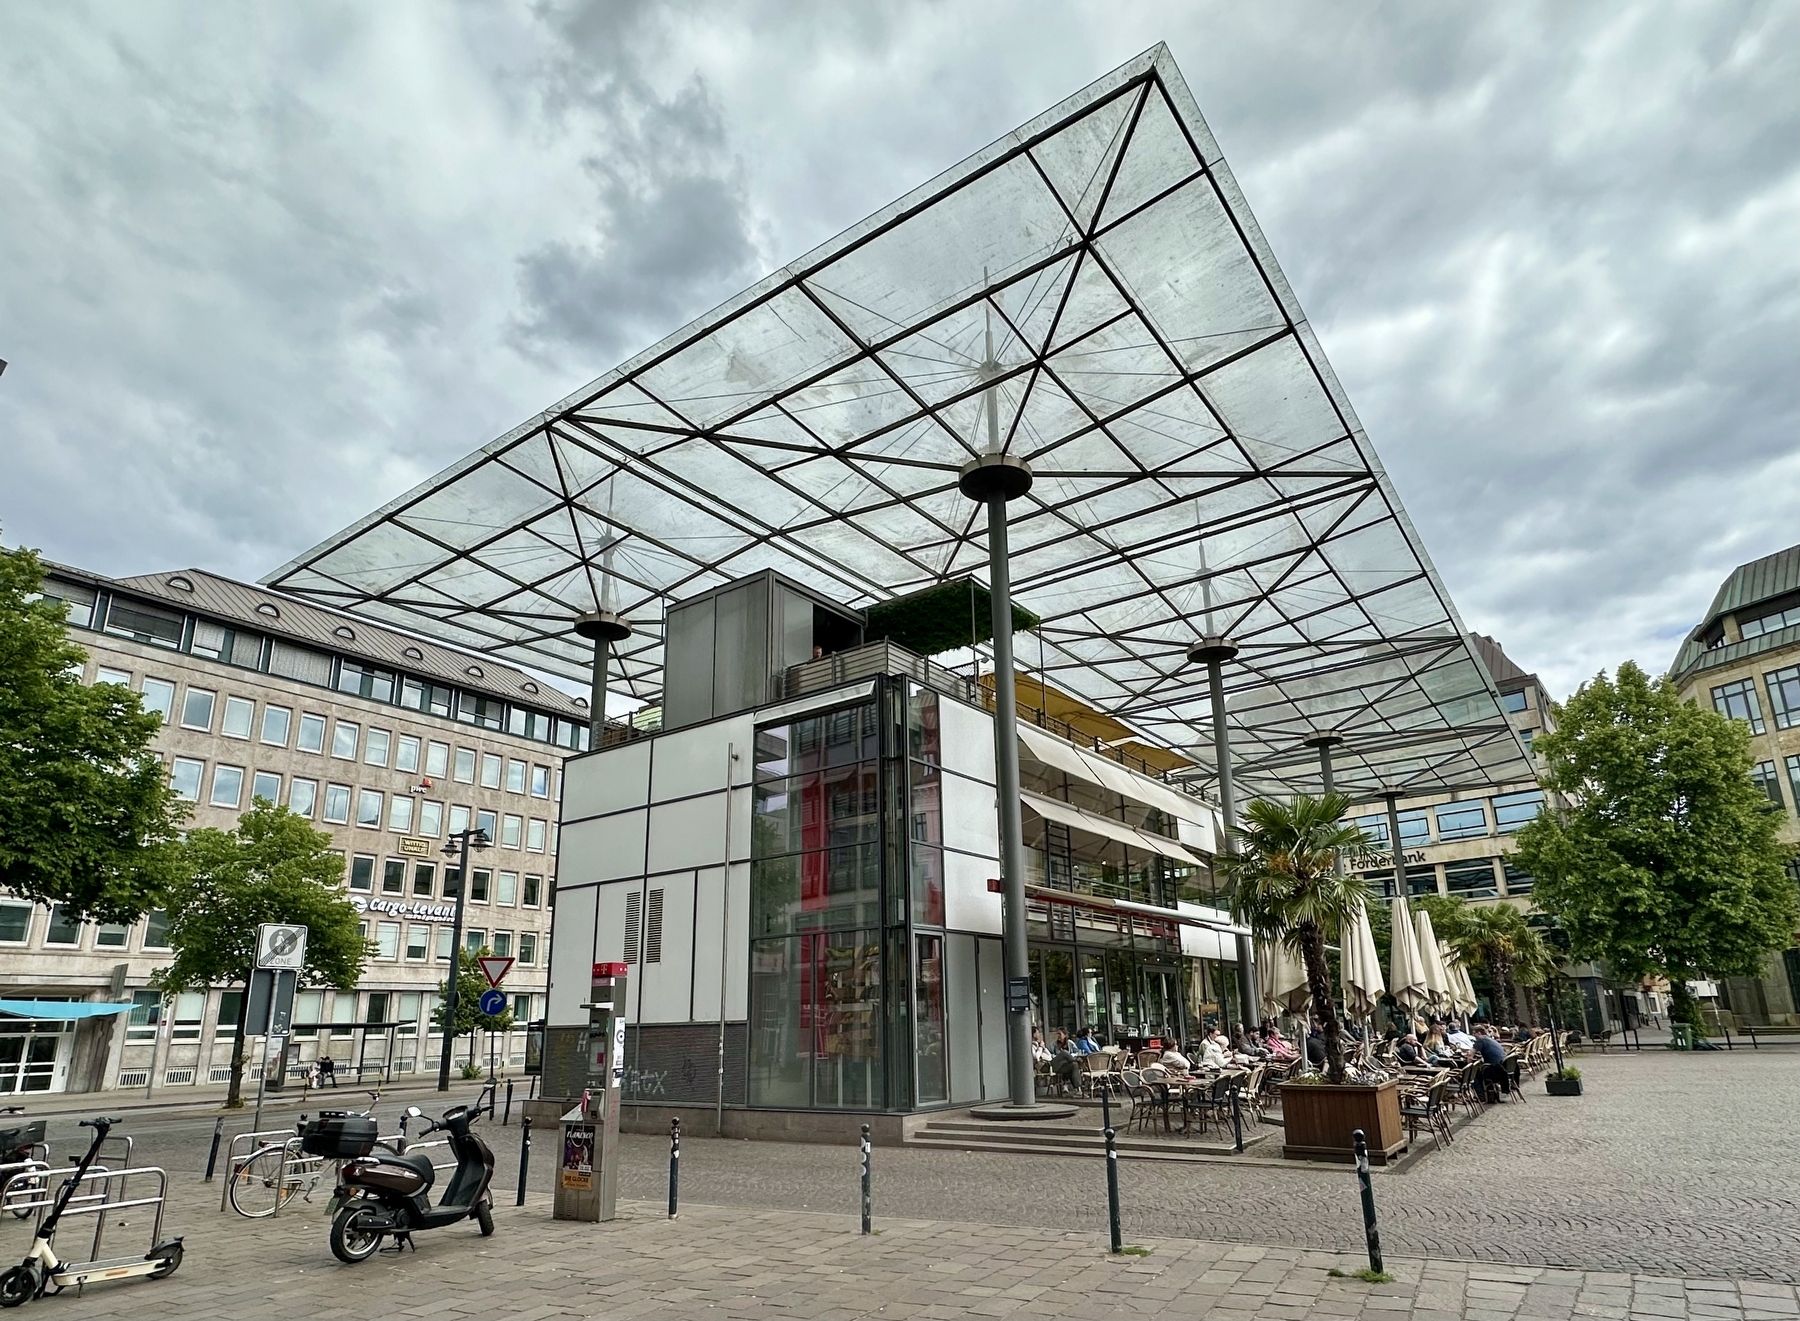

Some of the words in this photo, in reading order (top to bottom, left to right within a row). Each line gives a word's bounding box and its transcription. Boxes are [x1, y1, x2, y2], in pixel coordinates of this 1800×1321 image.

[410, 785, 427, 793] pwc
[1350, 850, 1426, 870] Förderank
[369, 898, 456, 917] Cargo-Levant
[270, 957, 292, 965] ZONE
